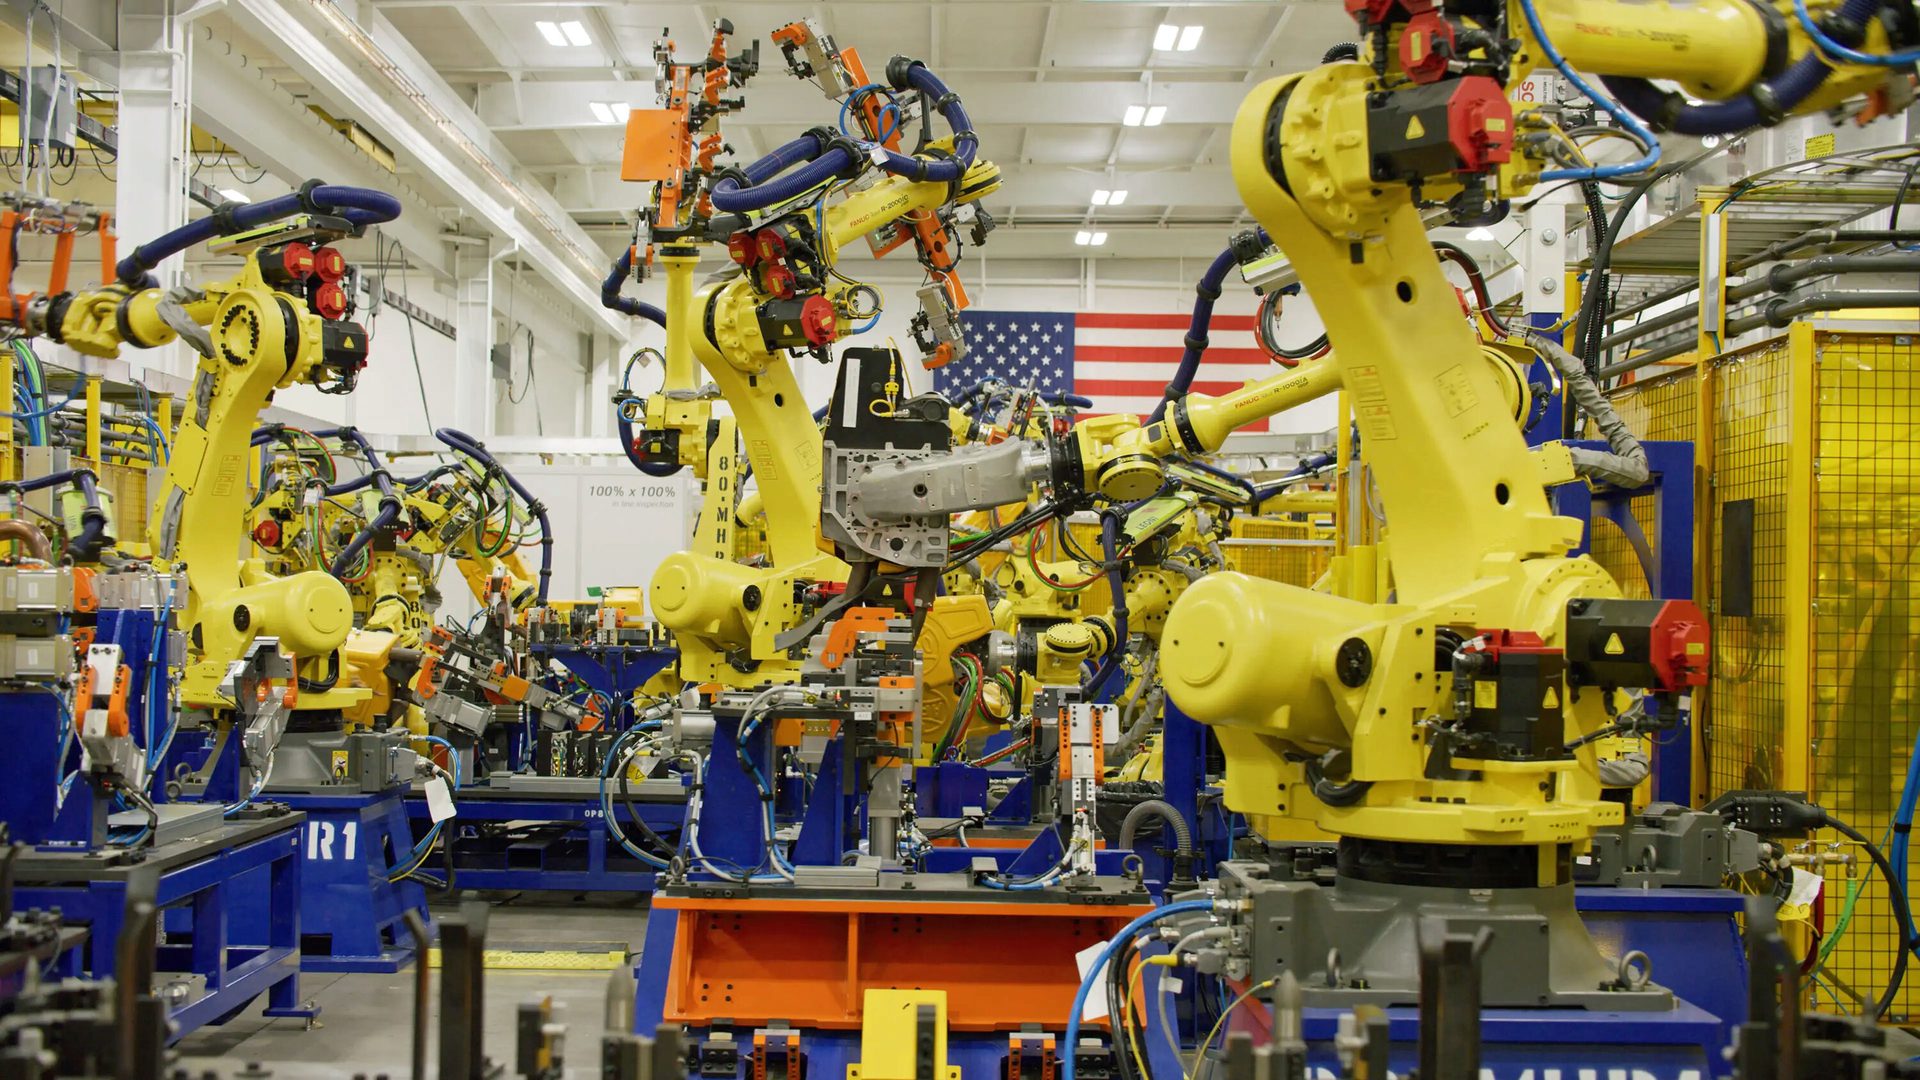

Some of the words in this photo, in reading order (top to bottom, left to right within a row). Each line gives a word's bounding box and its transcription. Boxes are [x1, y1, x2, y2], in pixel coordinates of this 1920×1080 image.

[849, 214, 870, 228] FANUC
[1234, 395, 1260, 409] FANUC
[589, 486, 625, 497] 100%
[628, 488, 637, 497] x
[641, 486, 676, 497] 100%
[307, 821, 357, 860] R1
